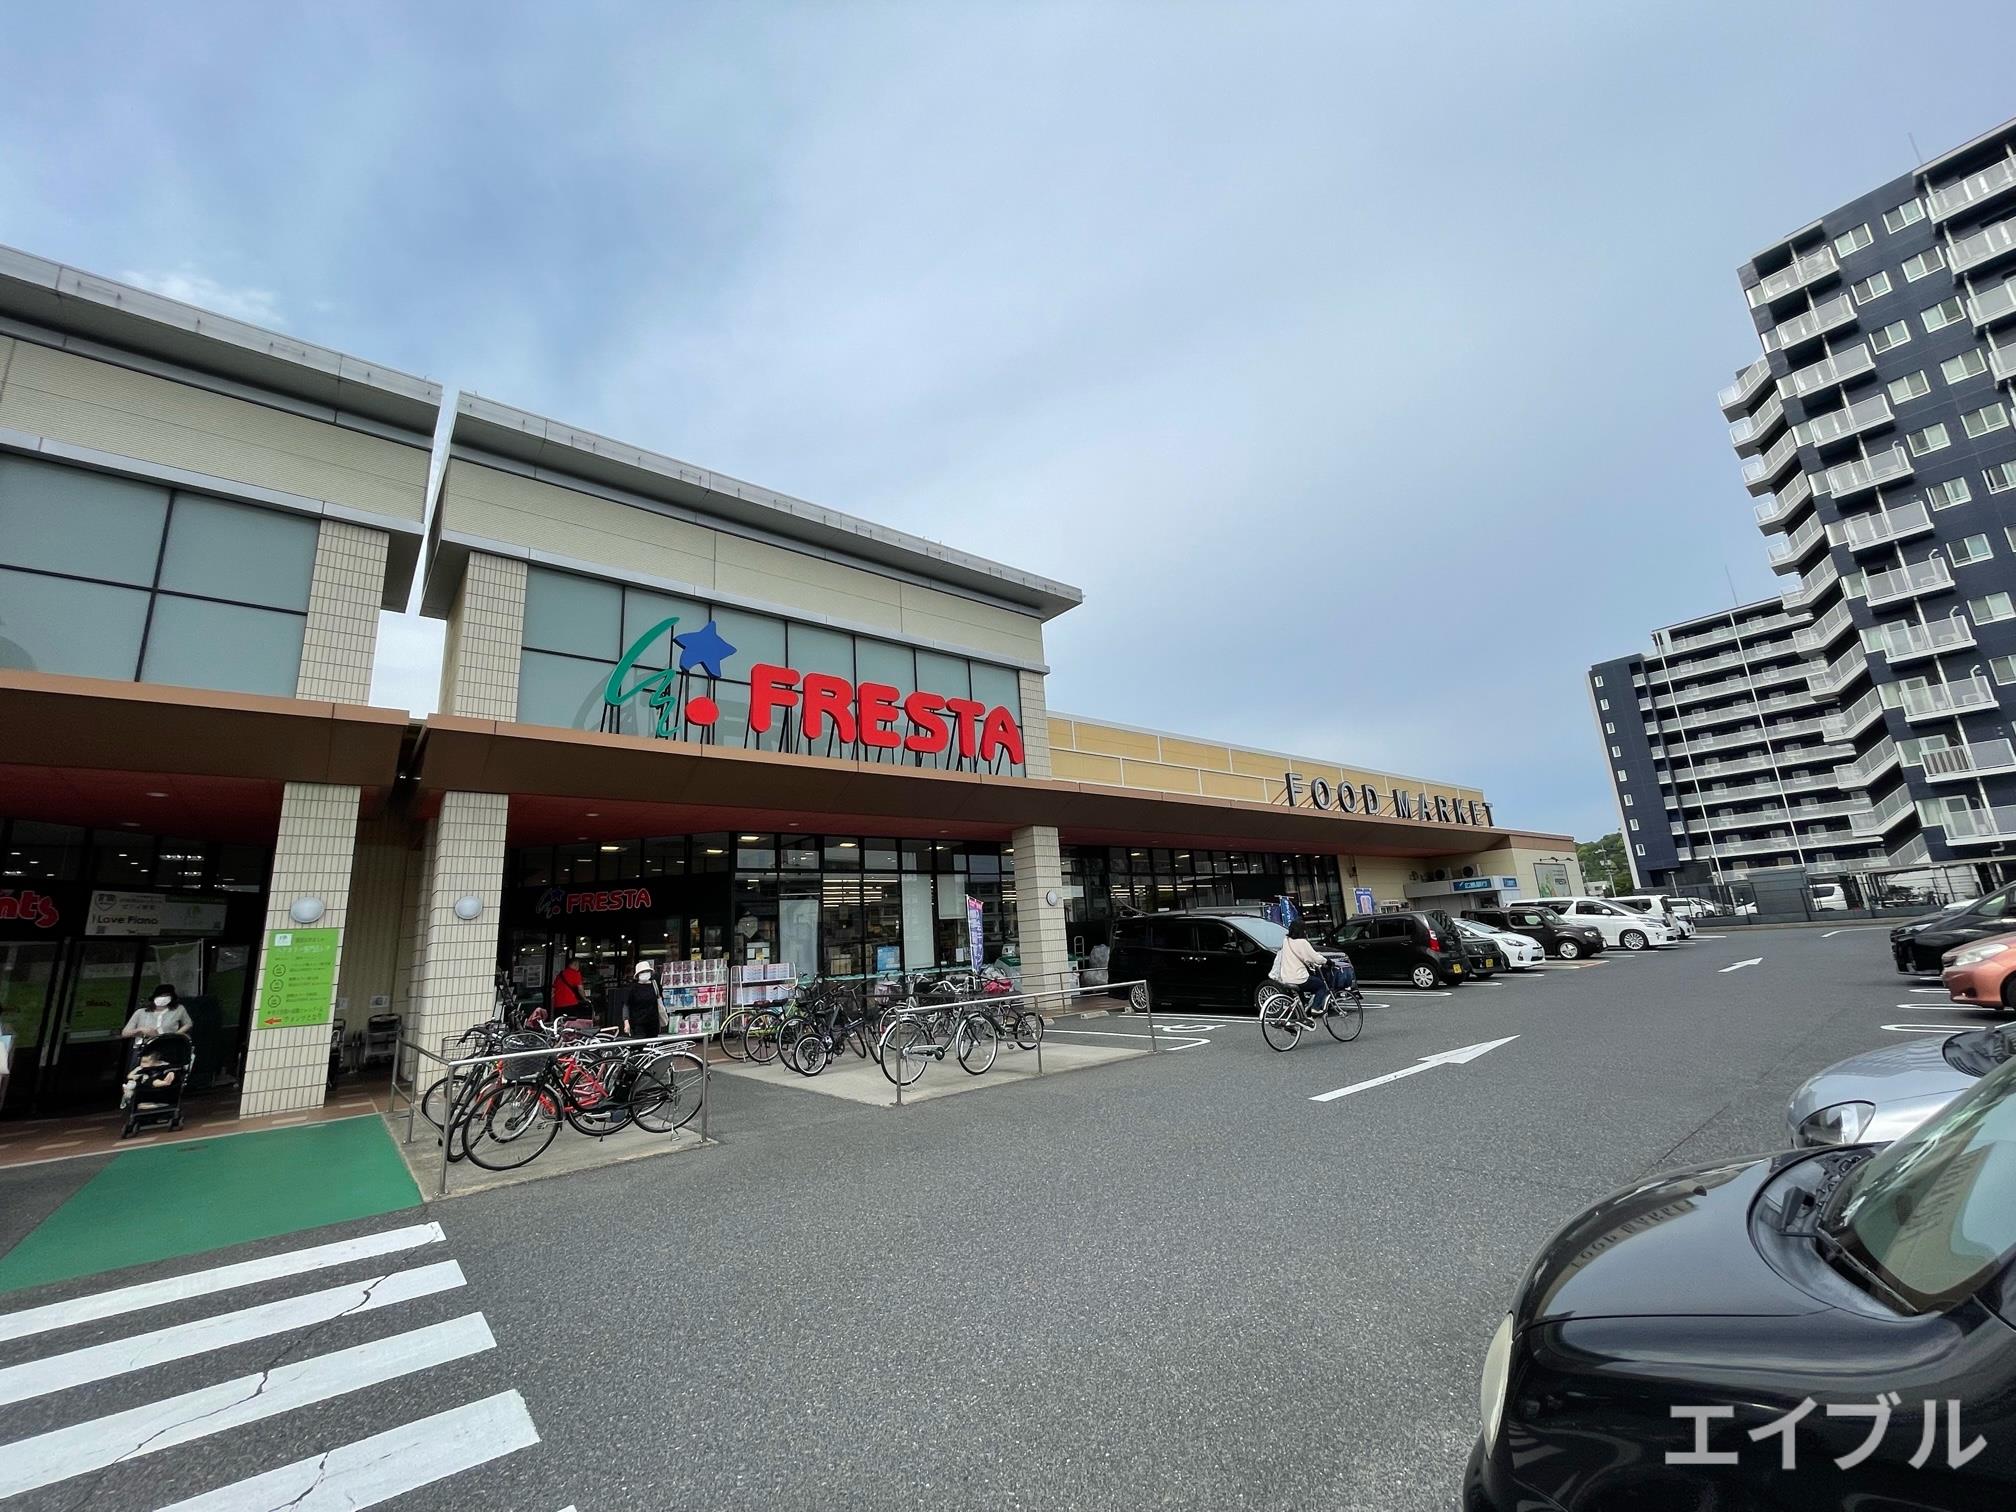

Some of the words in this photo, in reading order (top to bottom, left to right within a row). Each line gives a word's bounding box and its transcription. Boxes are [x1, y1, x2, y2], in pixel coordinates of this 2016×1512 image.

[750, 663, 1025, 765] FRESTA
[1285, 772, 1381, 816] FOOD
[1392, 788, 1496, 828] MARKET
[97, 915, 125, 925] Love
[128, 915, 159, 925] Piano
[566, 888, 652, 914] FRESTA
